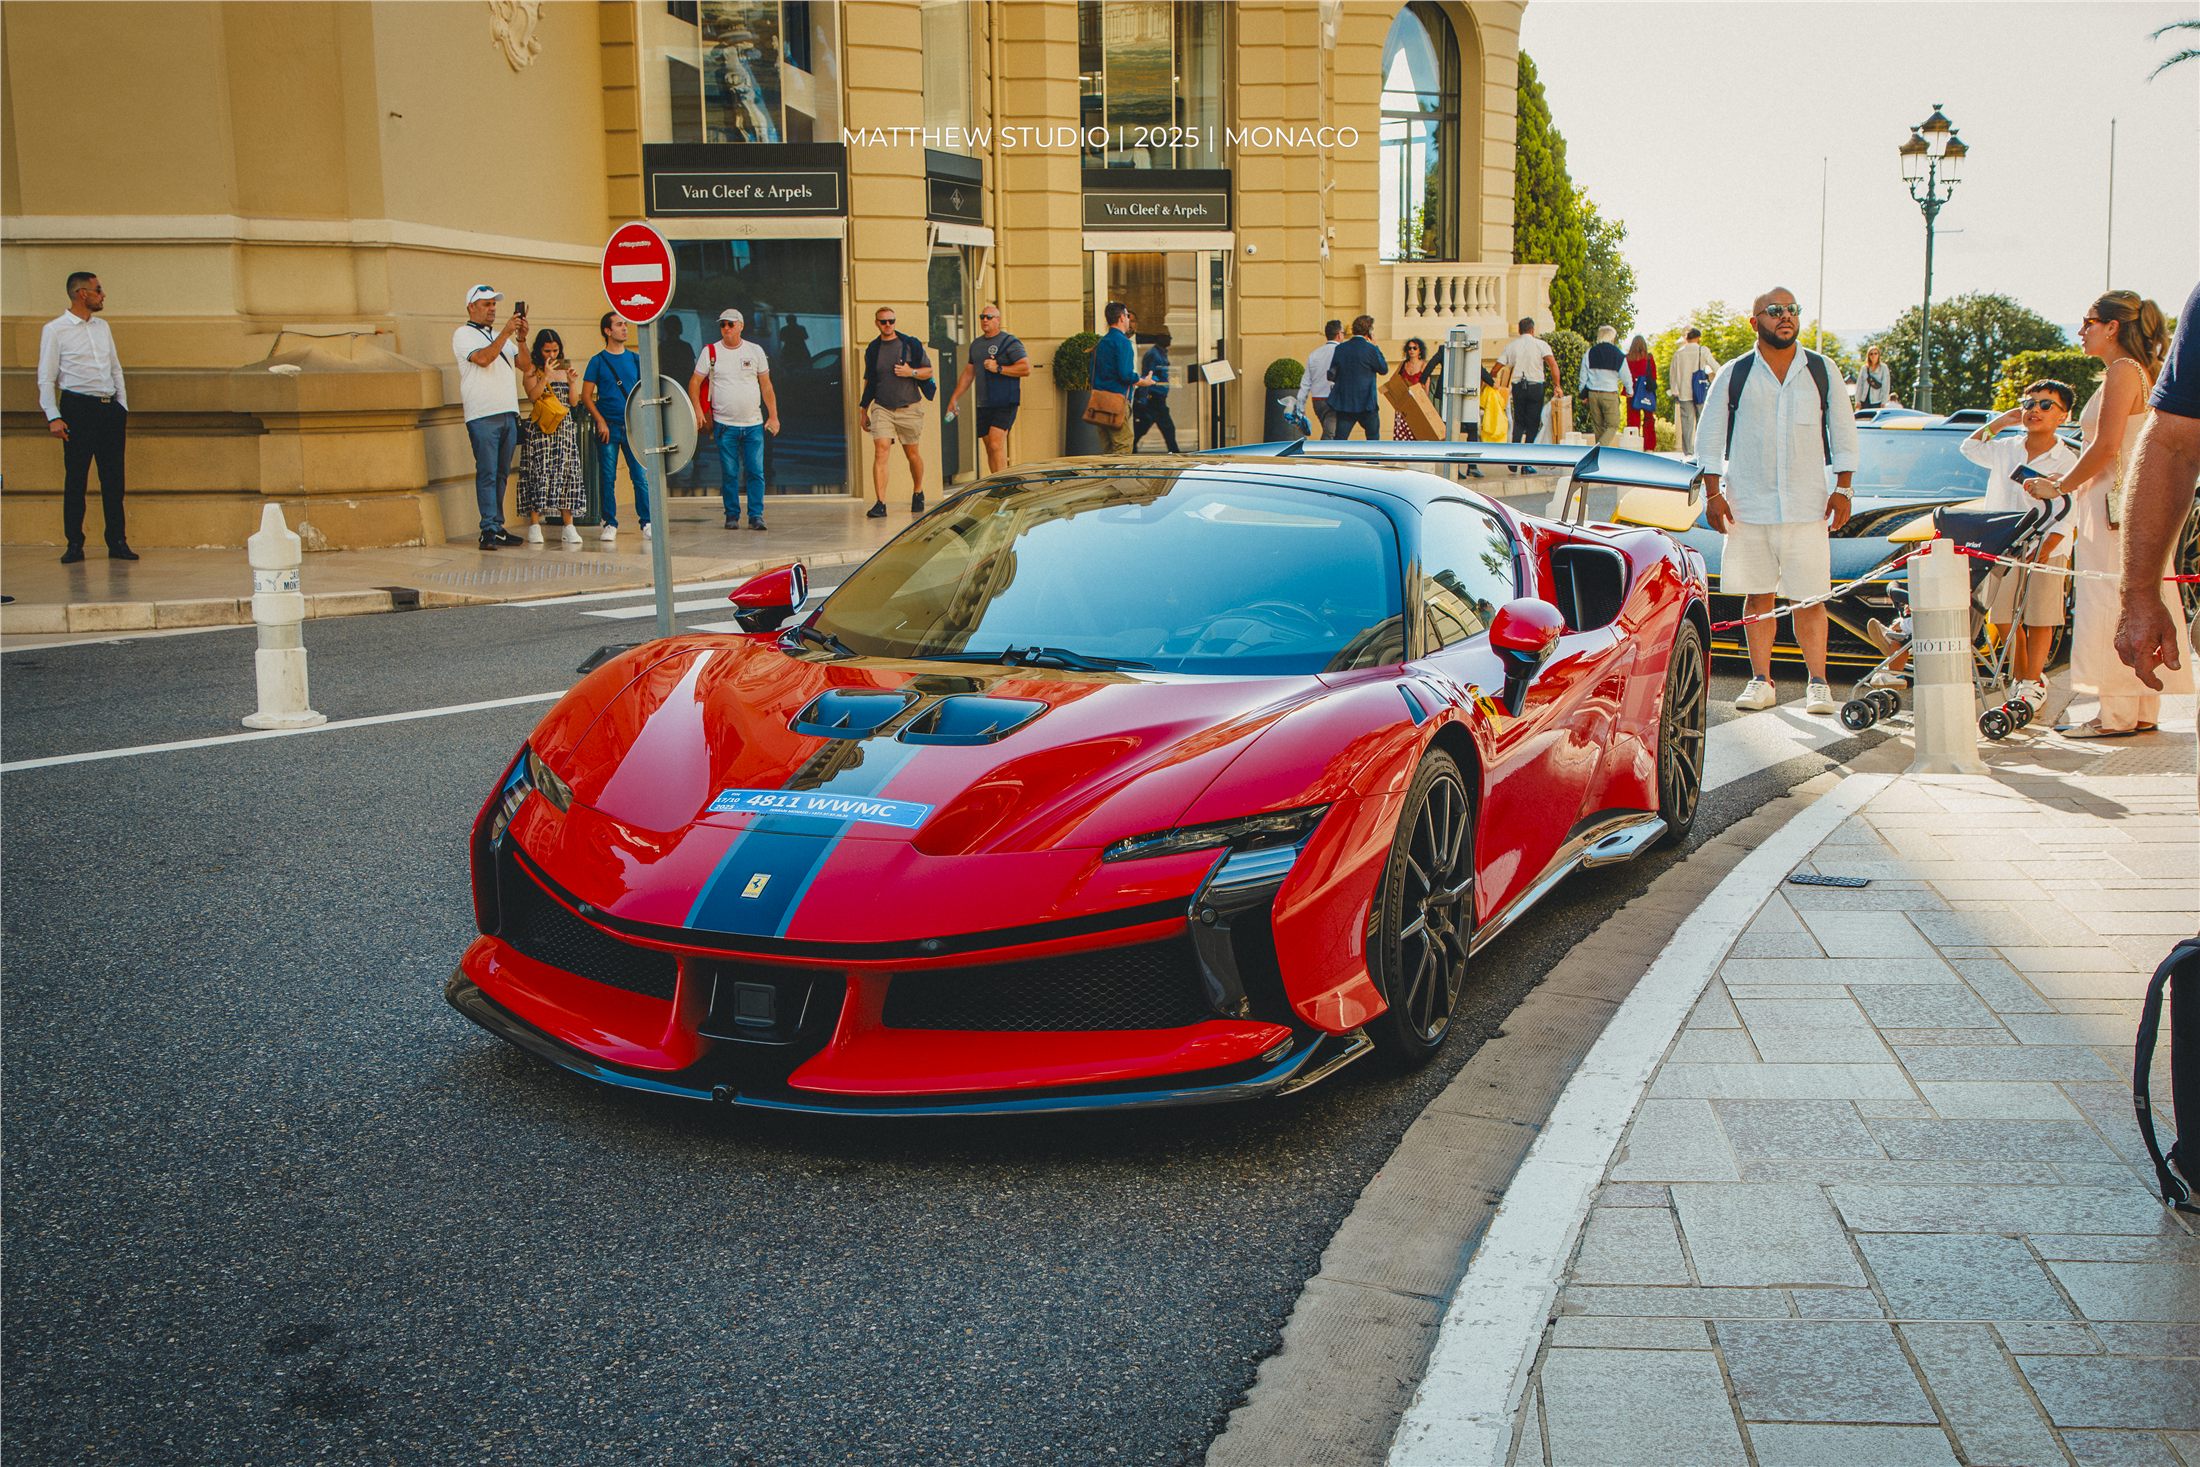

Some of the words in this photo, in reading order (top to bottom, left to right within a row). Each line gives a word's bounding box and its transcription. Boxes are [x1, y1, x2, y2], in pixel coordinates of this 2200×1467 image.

[681, 185, 709, 199] Van
[712, 184, 751, 199] Cleef
[754, 187, 765, 198] &
[768, 184, 813, 202] Arpels
[1105, 203, 1127, 216] Van
[1129, 203, 1160, 216] Cleef
[1162, 206, 1171, 216] &
[1172, 203, 1208, 219] Arpels
[1915, 639, 1964, 652] HÔTEL
[746, 794, 801, 808] 4811
[807, 797, 897, 818] WWMC
